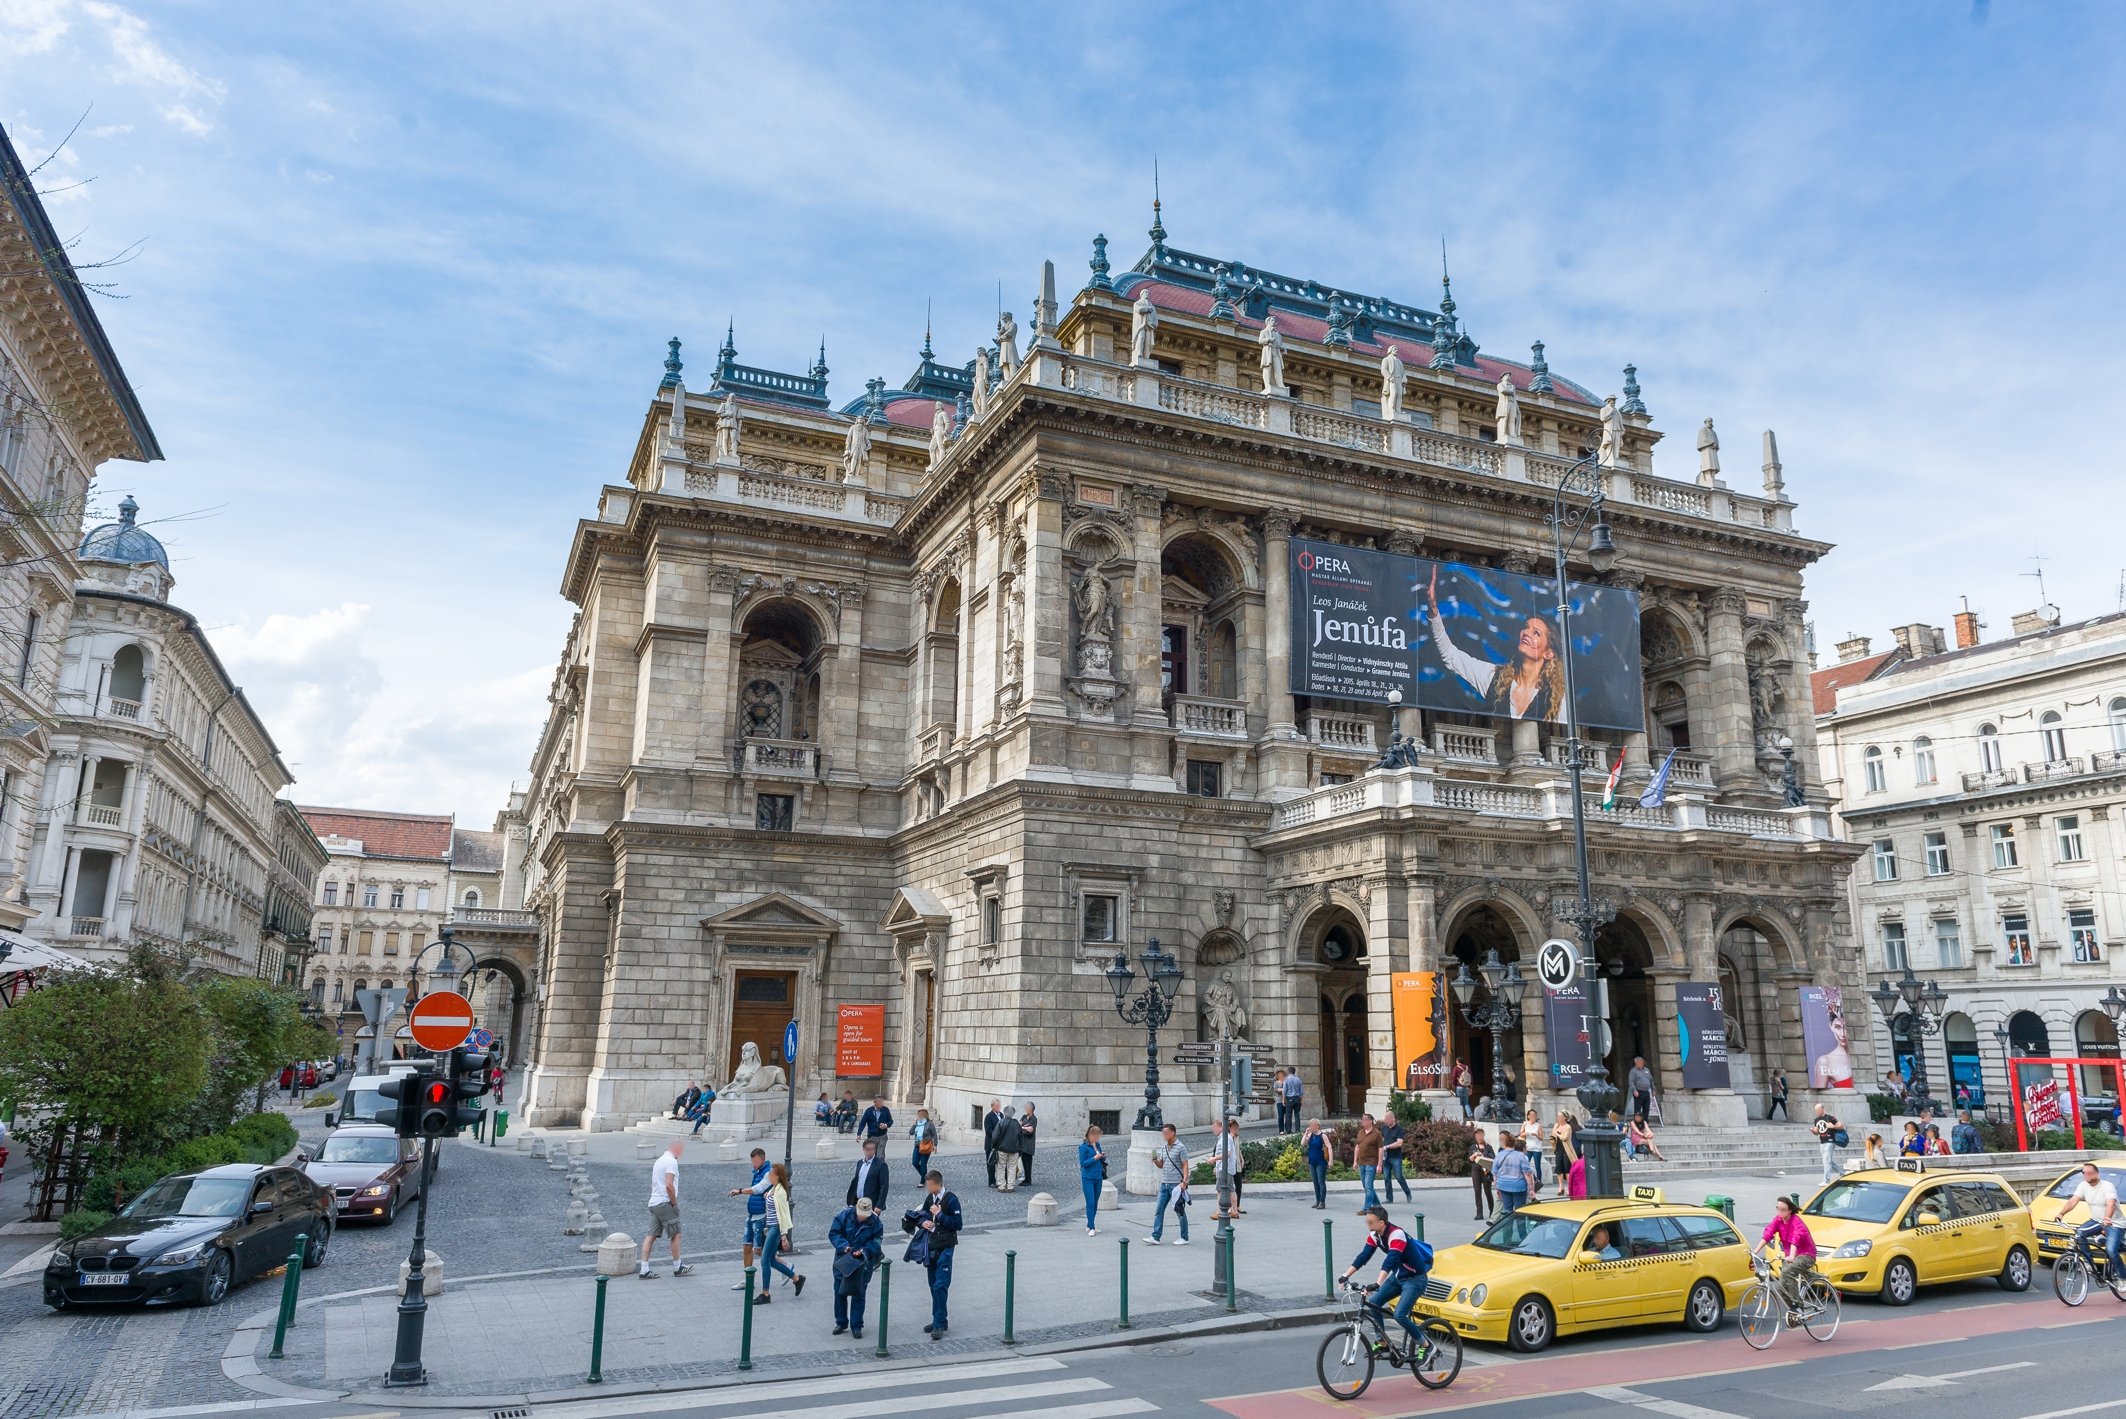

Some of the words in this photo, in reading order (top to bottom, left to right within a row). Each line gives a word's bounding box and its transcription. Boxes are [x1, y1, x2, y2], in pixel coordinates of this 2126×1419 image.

[1298, 551, 1351, 574] OPERA
[1333, 598, 1368, 612] Janáček
[1312, 609, 1408, 651] Jenůfa
[1312, 660, 1337, 670] Karmester
[1341, 663, 1365, 672] Conductor
[1371, 668, 1391, 676] Graeme
[1391, 670, 1411, 679] Jenkins
[1337, 654, 1356, 663] Director
[1394, 661, 1409, 670] Attila
[1354, 687, 1365, 695] and
[1543, 950, 1565, 978] M
[1552, 1064, 1582, 1075] ERKEL
[1637, 1188, 1654, 1197] TAXI
